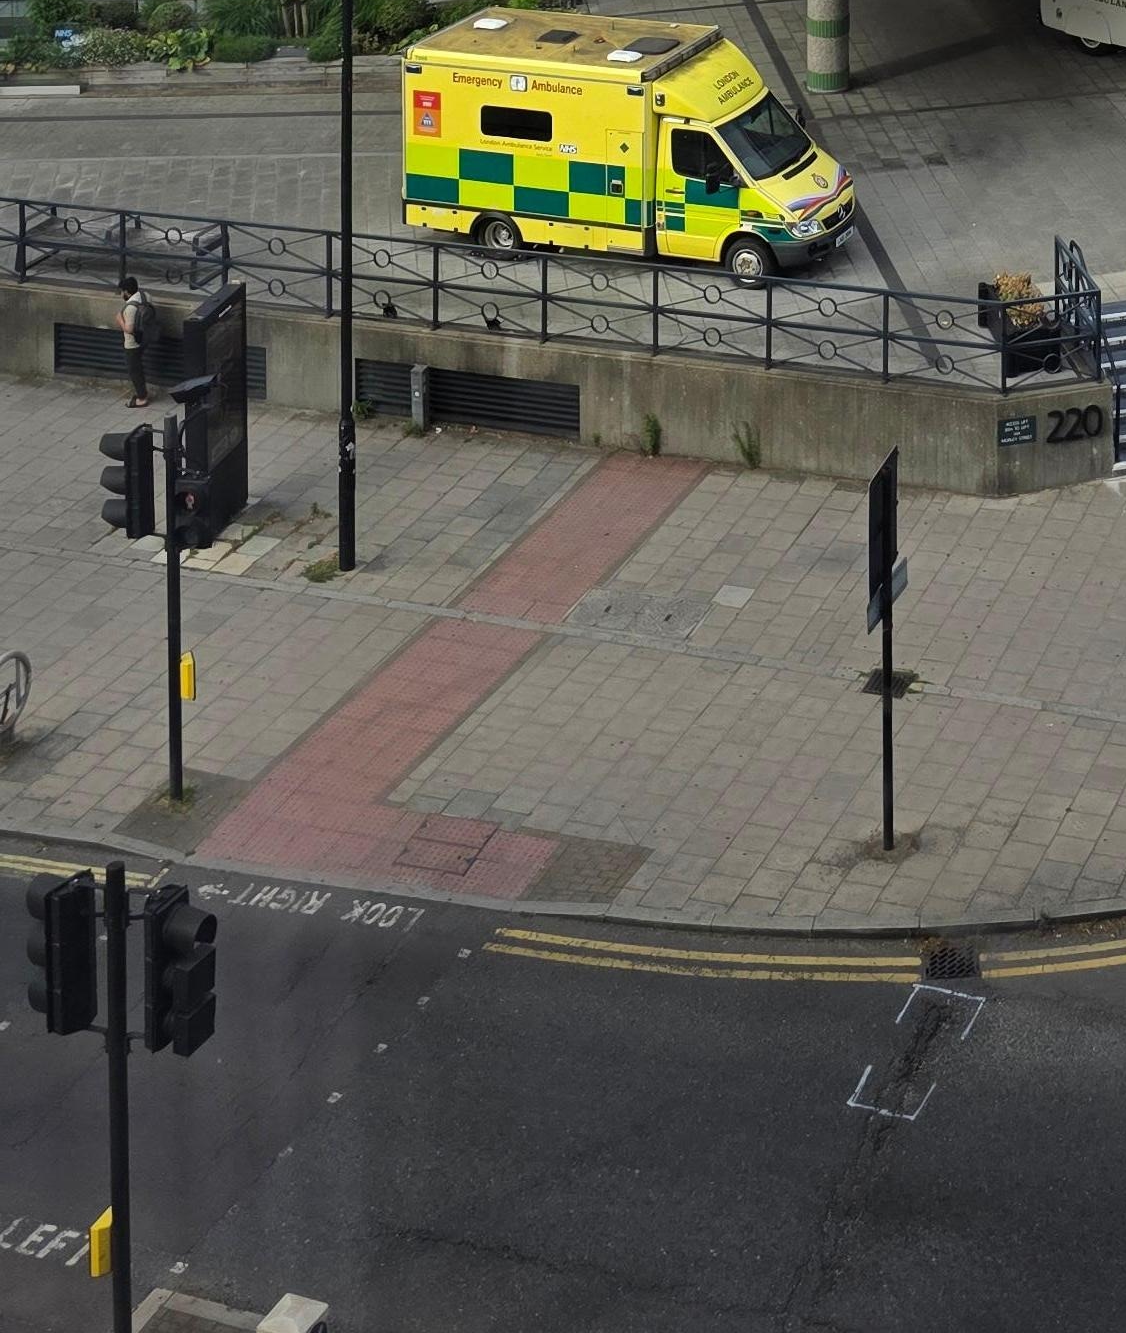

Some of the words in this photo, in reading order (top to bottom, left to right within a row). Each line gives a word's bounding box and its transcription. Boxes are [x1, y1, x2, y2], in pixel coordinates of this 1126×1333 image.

[452, 72, 503, 88] Emergency
[531, 80, 583, 96] Ambulance
[712, 70, 741, 90] LONDON
[717, 77, 755, 105] AMBULANCE
[501, 140, 532, 150] Ambulance
[560, 144, 578, 154] NHS
[1046, 404, 1104, 444] 220
[227, 881, 333, 916] RIGHT
[340, 898, 426, 933] LOOK
